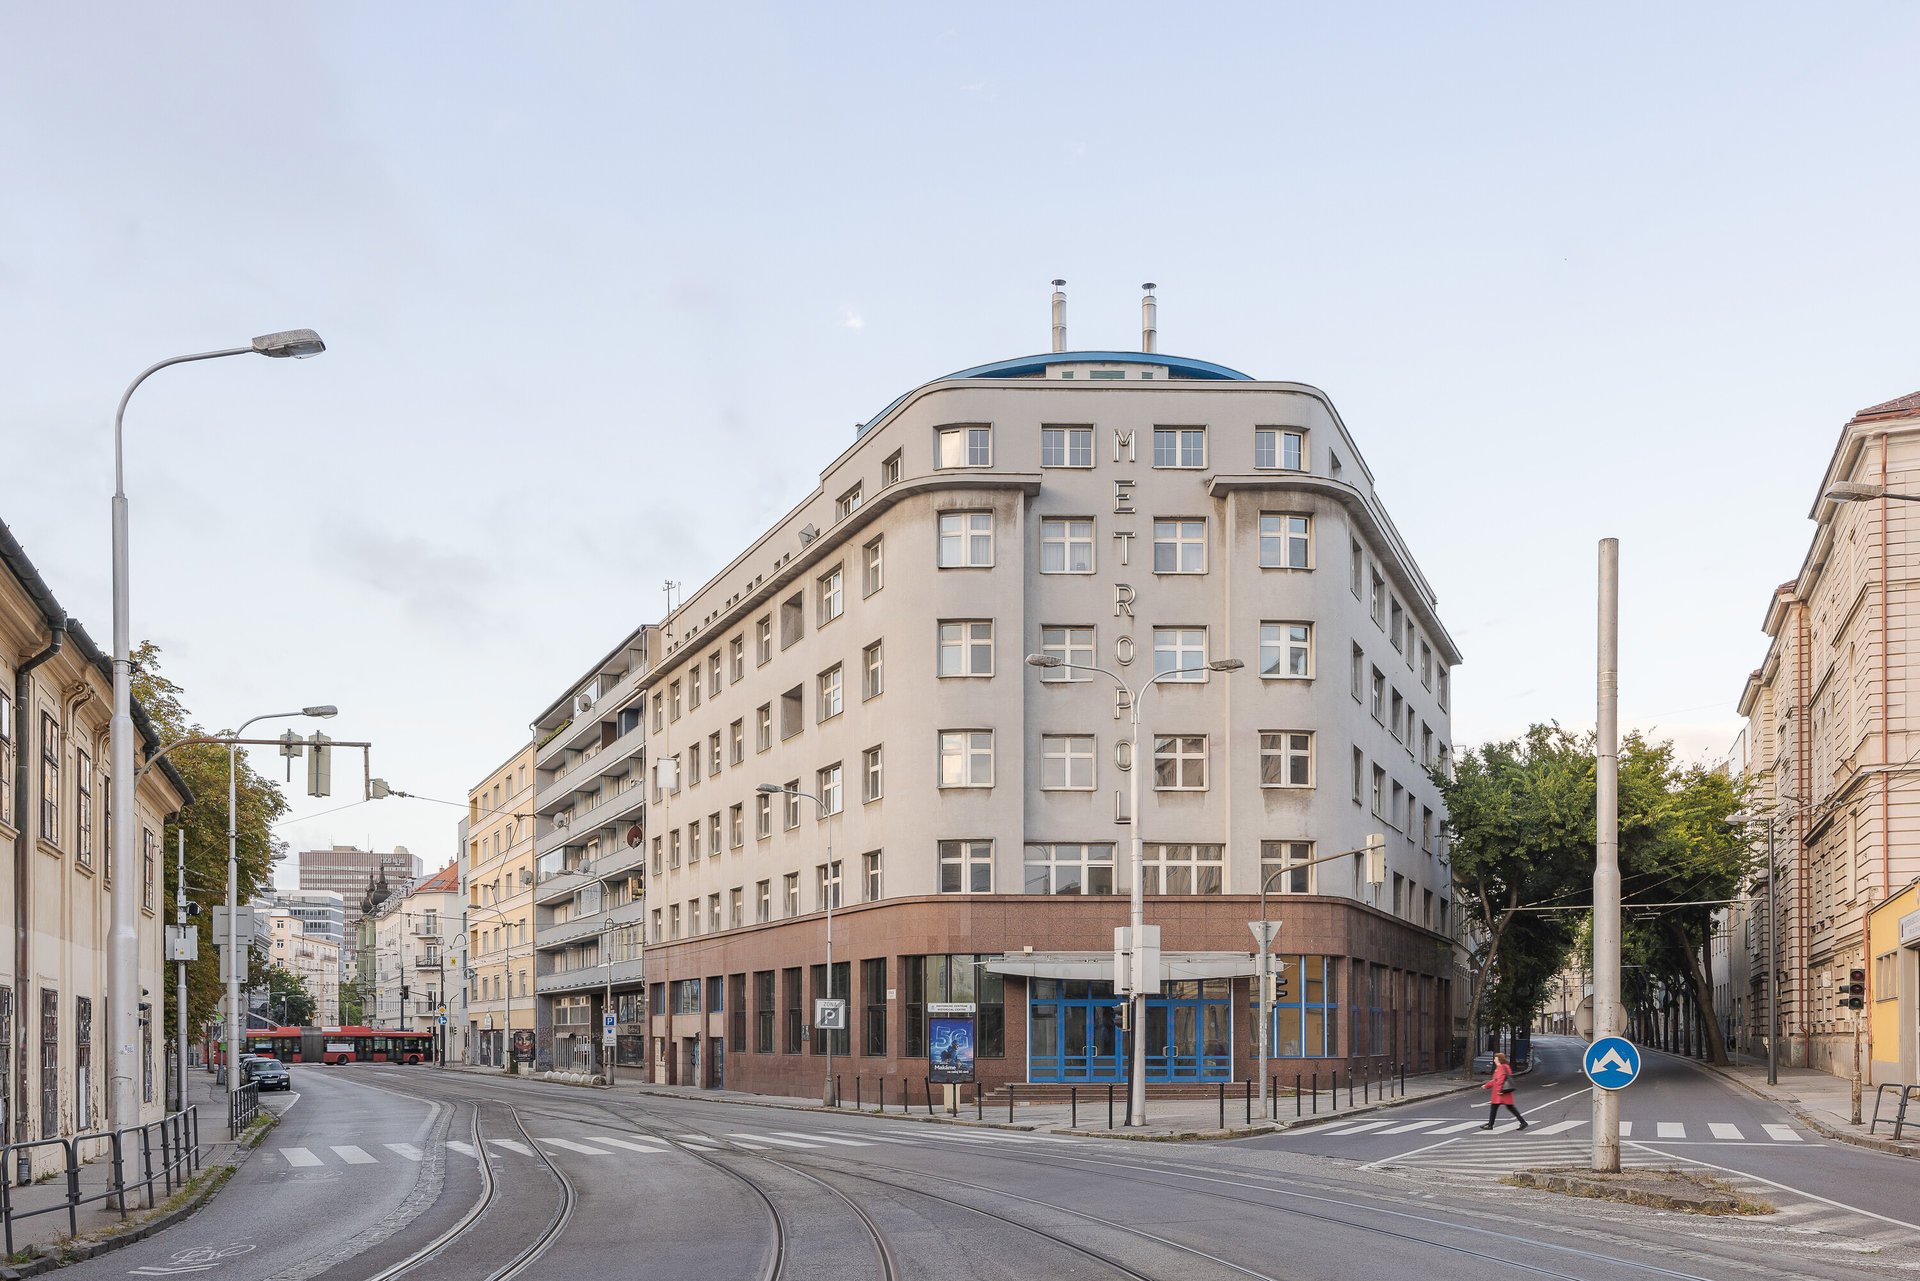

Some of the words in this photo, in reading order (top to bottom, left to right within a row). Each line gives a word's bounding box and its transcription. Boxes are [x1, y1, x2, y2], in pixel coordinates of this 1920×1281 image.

[1113, 429, 1136, 824] METROPOL
[825, 1010, 836, 1024] P
[935, 1026, 969, 1048] 5G
